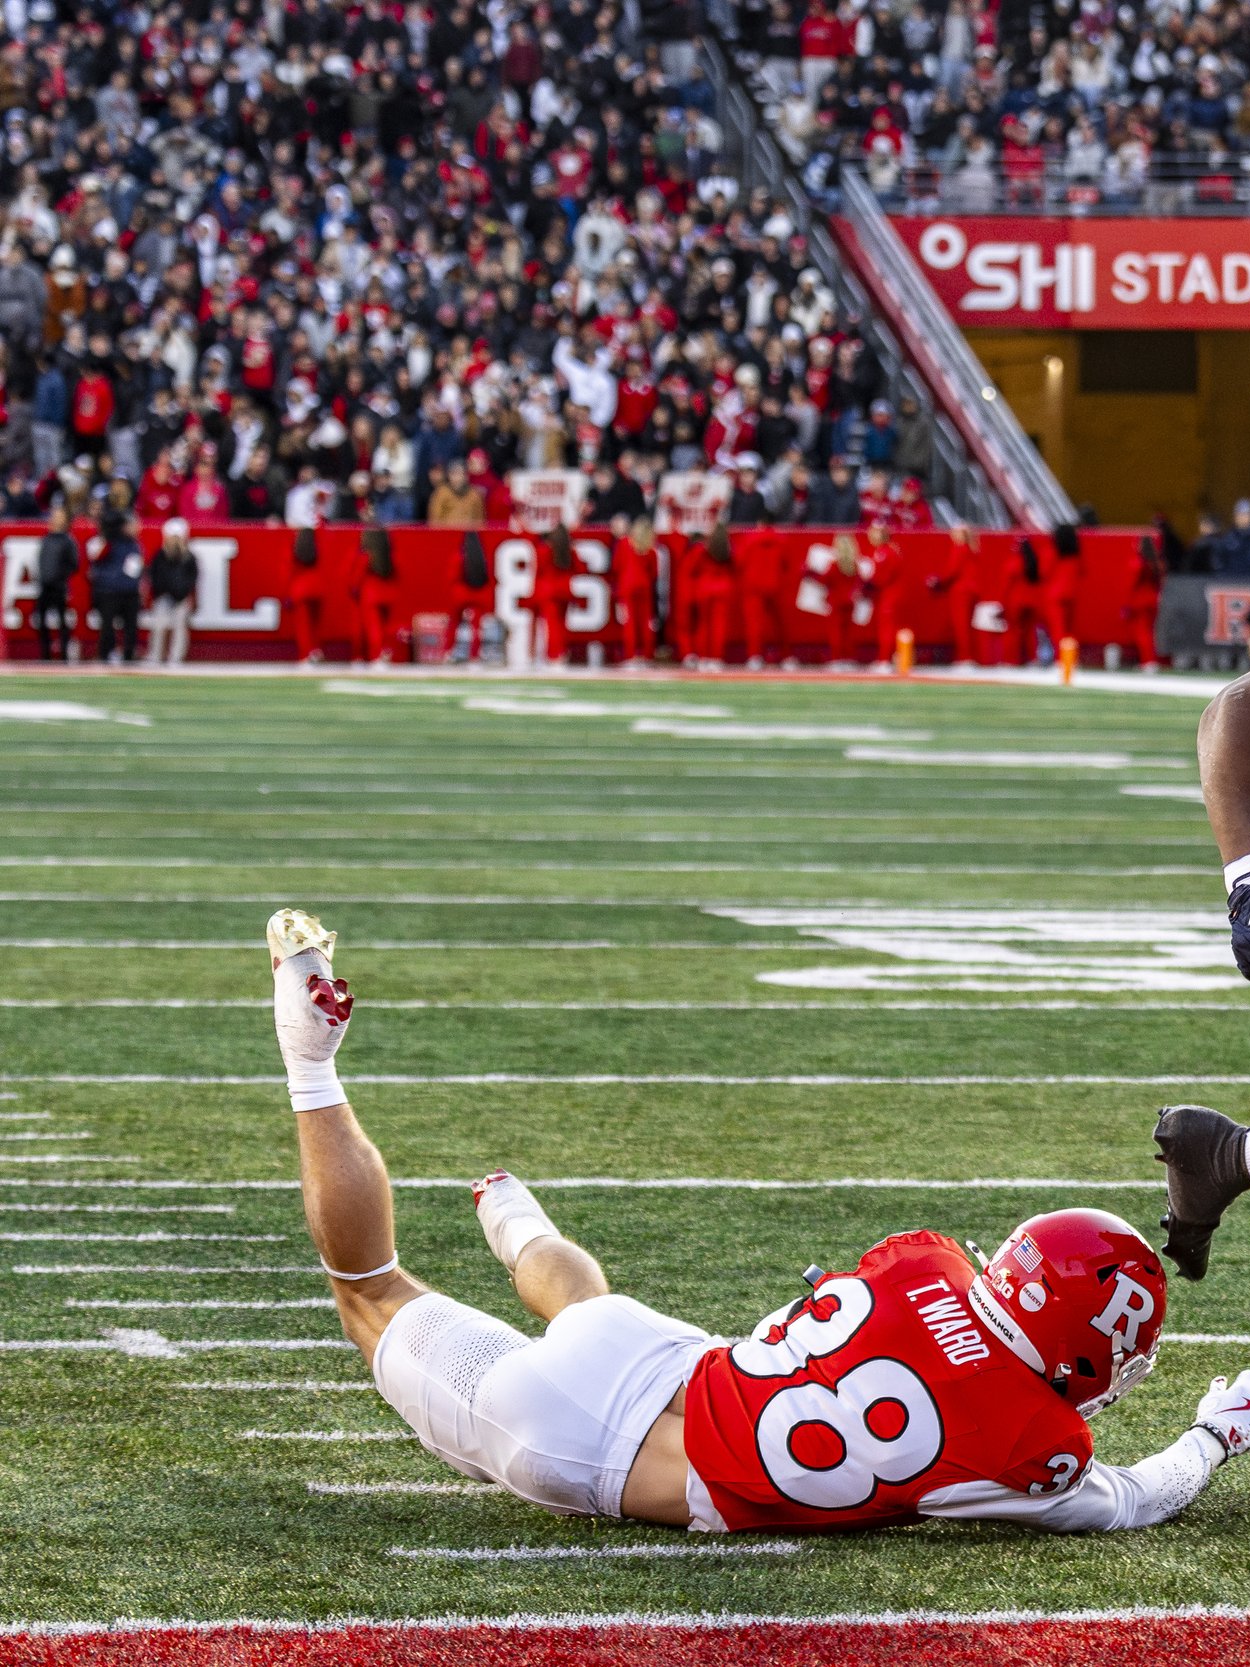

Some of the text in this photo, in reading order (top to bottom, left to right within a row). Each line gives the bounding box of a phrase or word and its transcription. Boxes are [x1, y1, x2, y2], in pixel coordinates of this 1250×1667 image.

[1022, 1286, 1043, 1308] BELIEVE
[1088, 1270, 1155, 1352] R
[729, 1277, 945, 1511] 38
